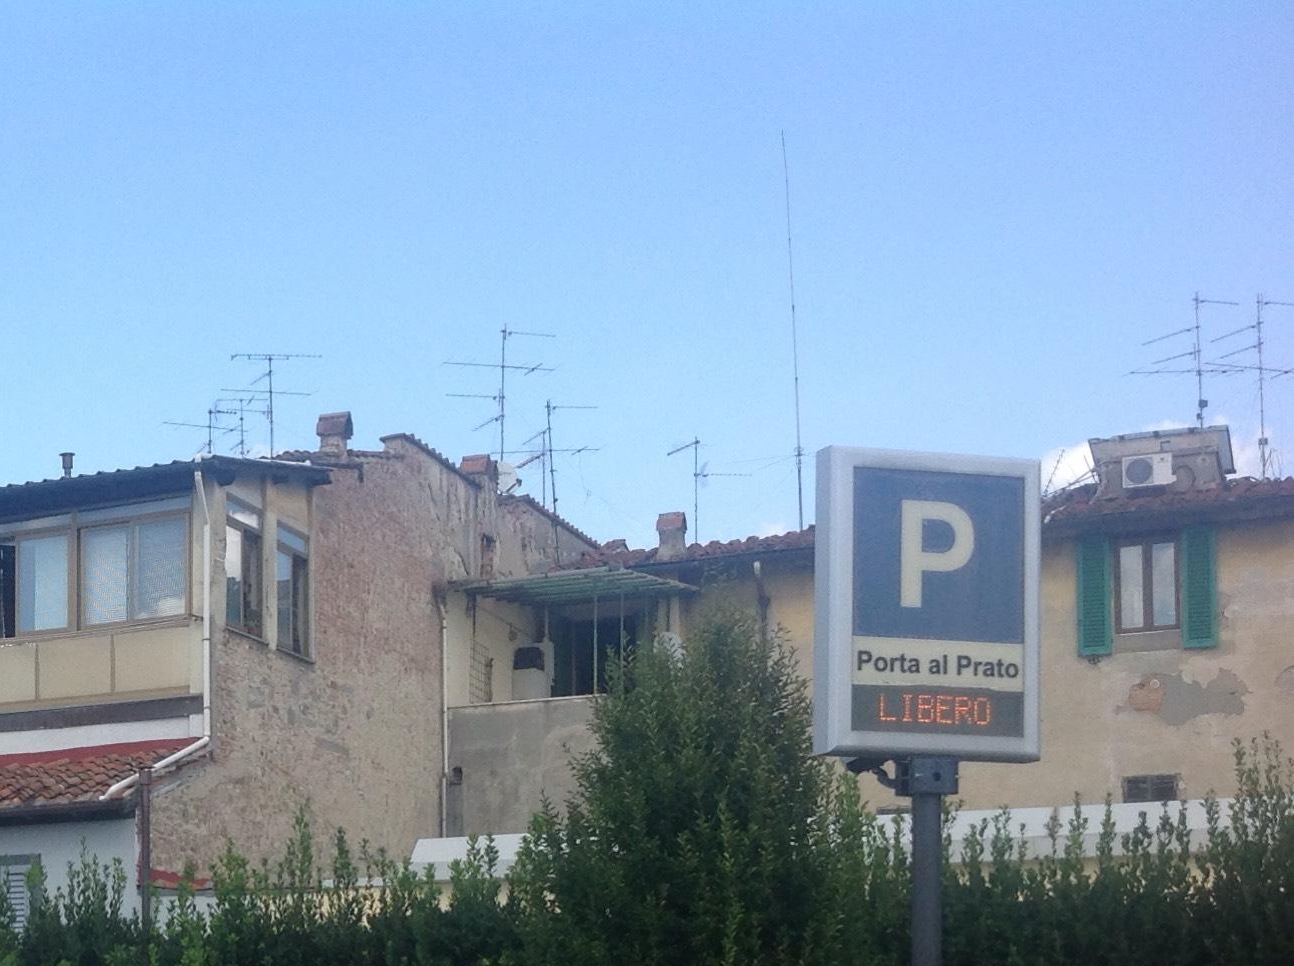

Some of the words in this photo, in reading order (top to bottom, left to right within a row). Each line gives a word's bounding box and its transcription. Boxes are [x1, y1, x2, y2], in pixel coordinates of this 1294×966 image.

[900, 499, 975, 608] P
[856, 650, 920, 674] Porta
[928, 654, 949, 676] al
[956, 655, 1020, 679] Prato
[878, 693, 992, 725] LIBERO
